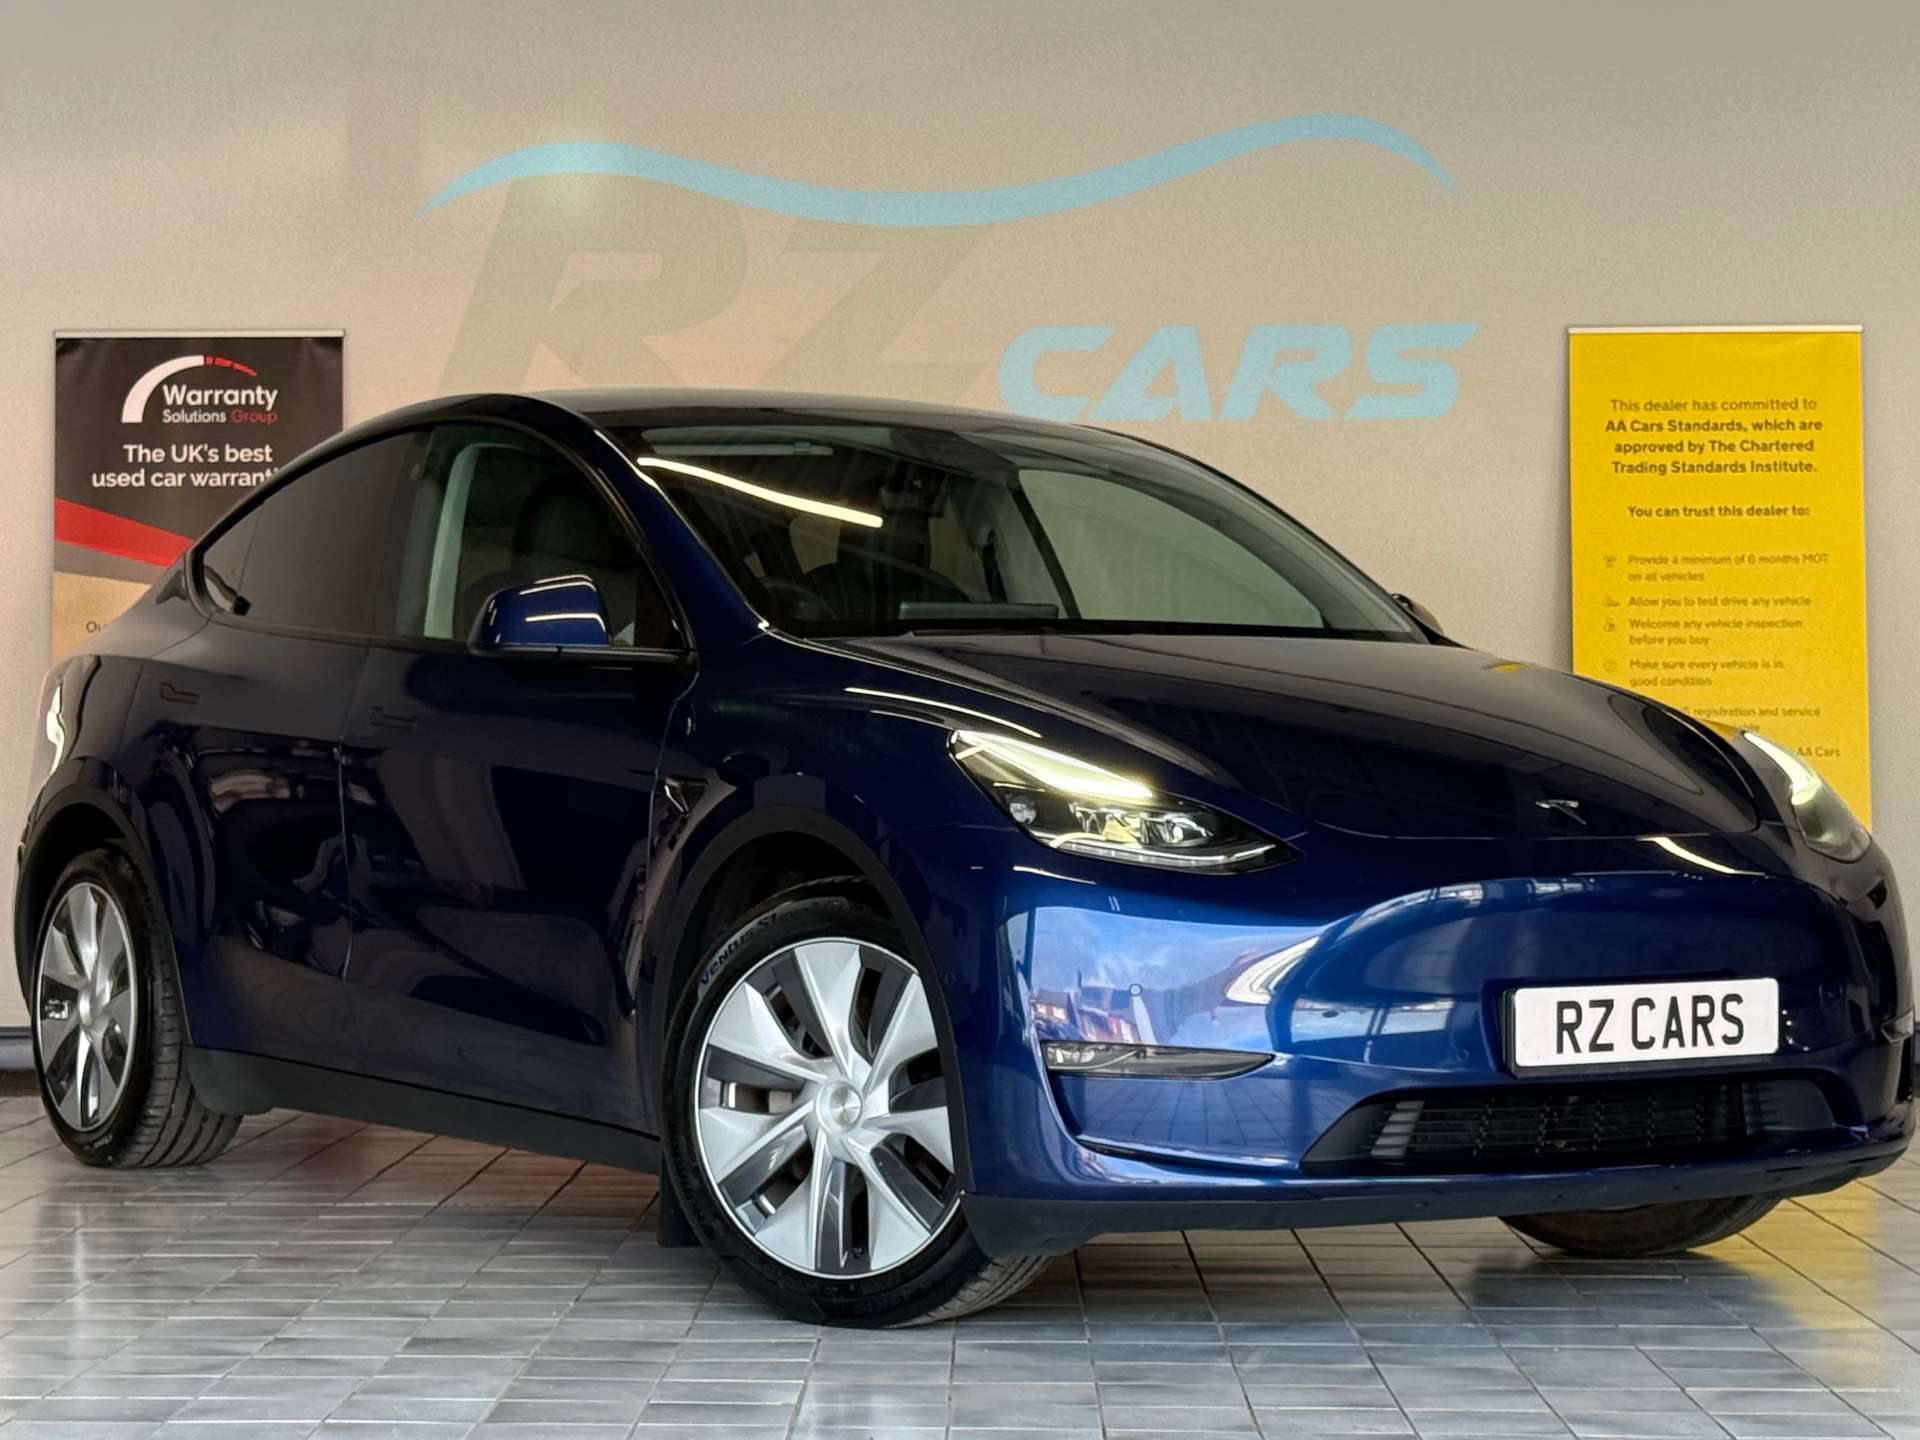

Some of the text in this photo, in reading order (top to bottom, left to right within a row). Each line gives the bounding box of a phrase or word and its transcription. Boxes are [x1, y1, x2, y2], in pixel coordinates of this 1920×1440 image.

[438, 172, 1478, 422] RZ CARS
[162, 384, 278, 411] Warranty
[1610, 398, 1818, 412] This dealer has committed to
[162, 409, 278, 425] Solutions Group
[1605, 419, 1823, 433] AA Cars Standards, which are
[122, 444, 273, 463] The UK's best
[1614, 440, 1815, 455] approved by The Chartered
[1611, 460, 1818, 476] Trading Standards Institute.
[91, 468, 146, 488] used
[151, 472, 186, 488] car
[1627, 505, 1811, 518] You can trust this dealer to:
[1627, 553, 1829, 566] Provide a minimum of 6 months MOT
[1627, 572, 1705, 582] on all vehicles
[1627, 596, 1812, 608] Allow you to test drive any vehicle
[1628, 618, 1803, 630] Welcome any vehicle inspection
[1628, 634, 1710, 647] before you buy
[1629, 659, 1785, 672] Make sure every vehicle is in
[1629, 676, 1713, 689] good condition
[1692, 706, 1756, 719] registration
[1757, 706, 1779, 717] and
[1781, 706, 1821, 717] service
[1814, 747, 1841, 757] Cars
[1556, 993, 1745, 1054] RZ CARS
